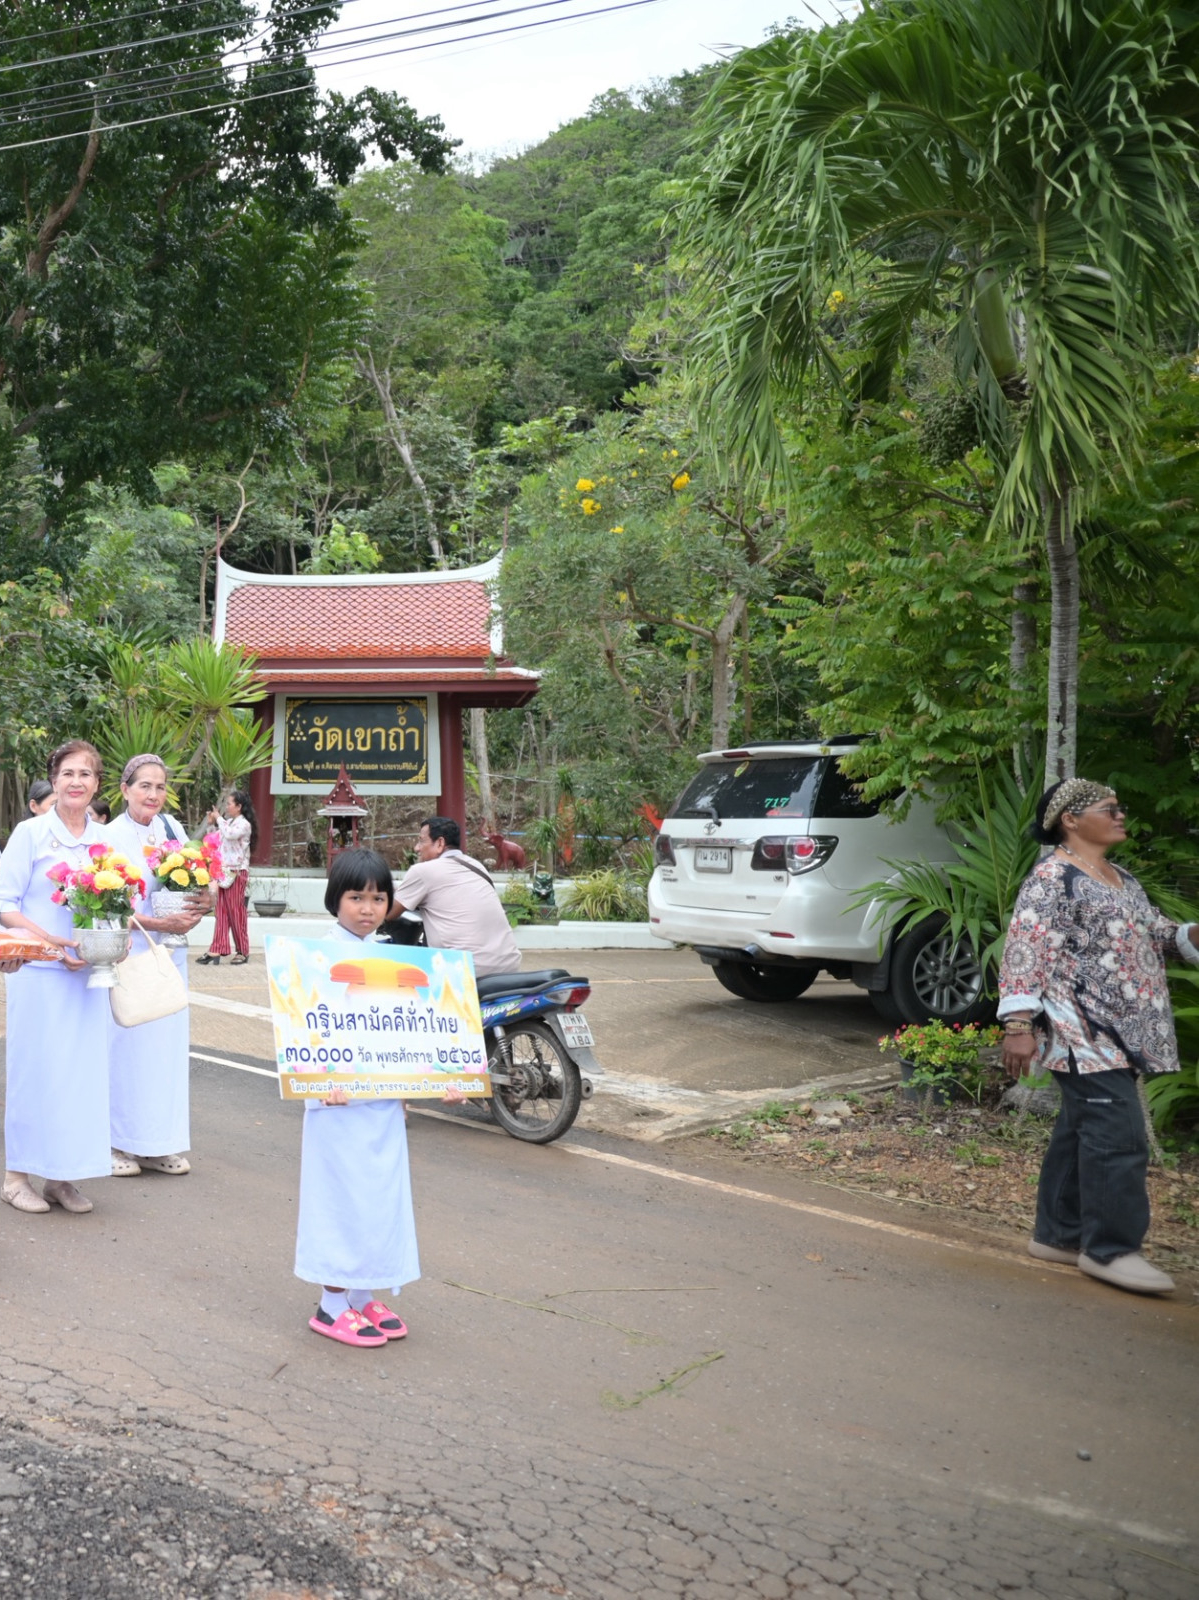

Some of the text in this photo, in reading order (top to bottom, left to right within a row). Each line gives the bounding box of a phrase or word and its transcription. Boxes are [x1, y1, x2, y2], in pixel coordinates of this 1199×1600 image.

[308, 705, 420, 752] วัดเขาถ้ำ
[764, 797, 791, 808] 717
[710, 851, 727, 862] 2914
[305, 1000, 458, 1038] กฐินสามัคคีทั่วไทย
[483, 1001, 522, 1019] Wave
[286, 1046, 482, 1069] ๓๐,๐๐๐ วัด พุทธศักราช ๒๕๖๘
[291, 1080, 307, 1091] โดย
